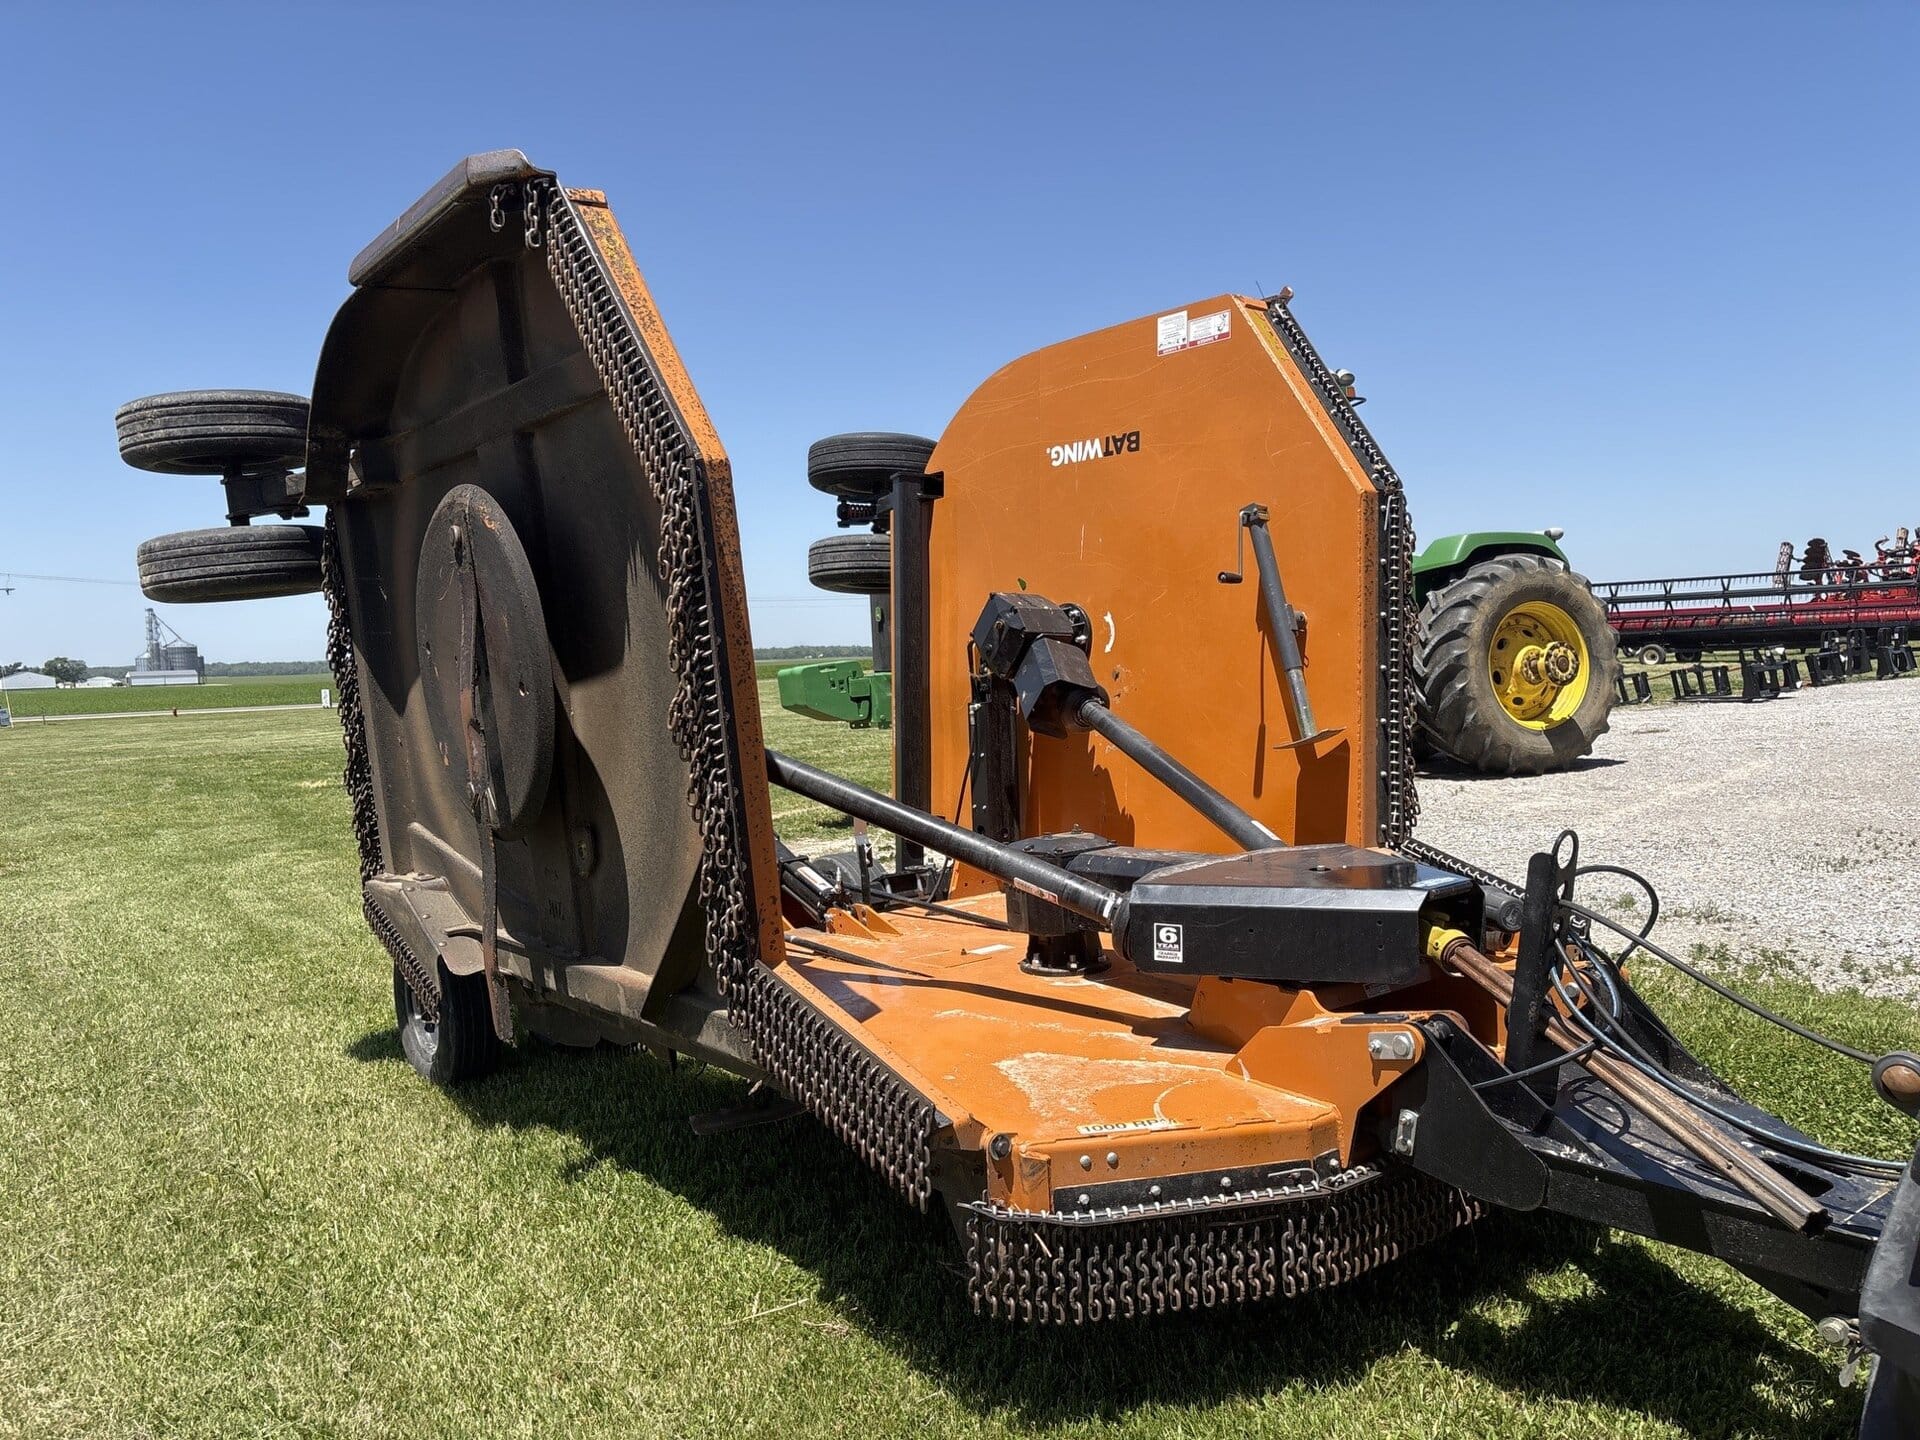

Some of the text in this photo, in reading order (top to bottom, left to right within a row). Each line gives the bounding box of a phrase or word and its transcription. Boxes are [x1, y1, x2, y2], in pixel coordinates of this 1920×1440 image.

[1159, 926, 1178, 944] 6
[1156, 942, 1180, 950] YEAR
[1083, 1122, 1127, 1132] 1000
